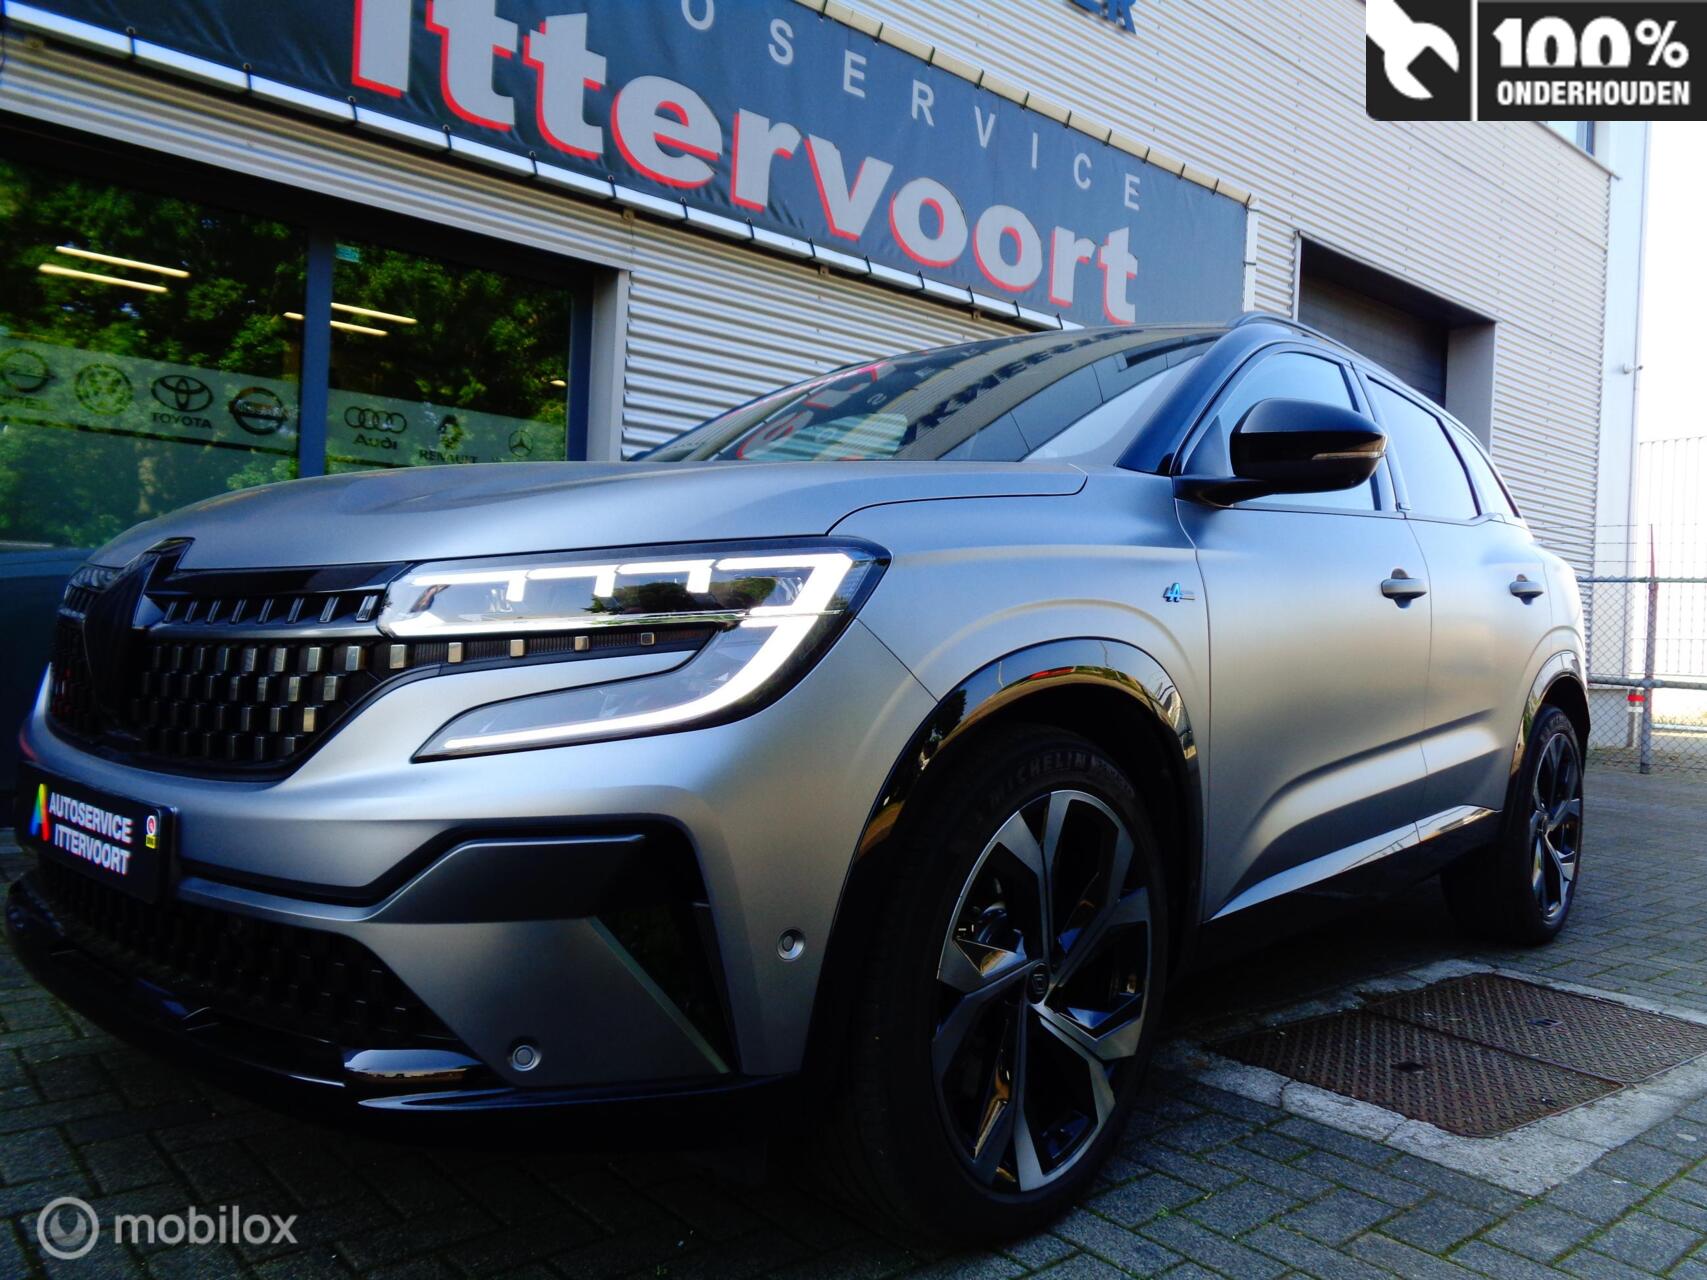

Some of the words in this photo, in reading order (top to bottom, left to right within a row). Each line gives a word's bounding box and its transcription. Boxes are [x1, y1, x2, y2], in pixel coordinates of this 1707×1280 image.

[150, 412, 212, 430] TOYOTA
[352, 433, 398, 450] Audi
[48, 791, 134, 844] AUTOSERVICE
[53, 823, 131, 876] ITTERVOORT
